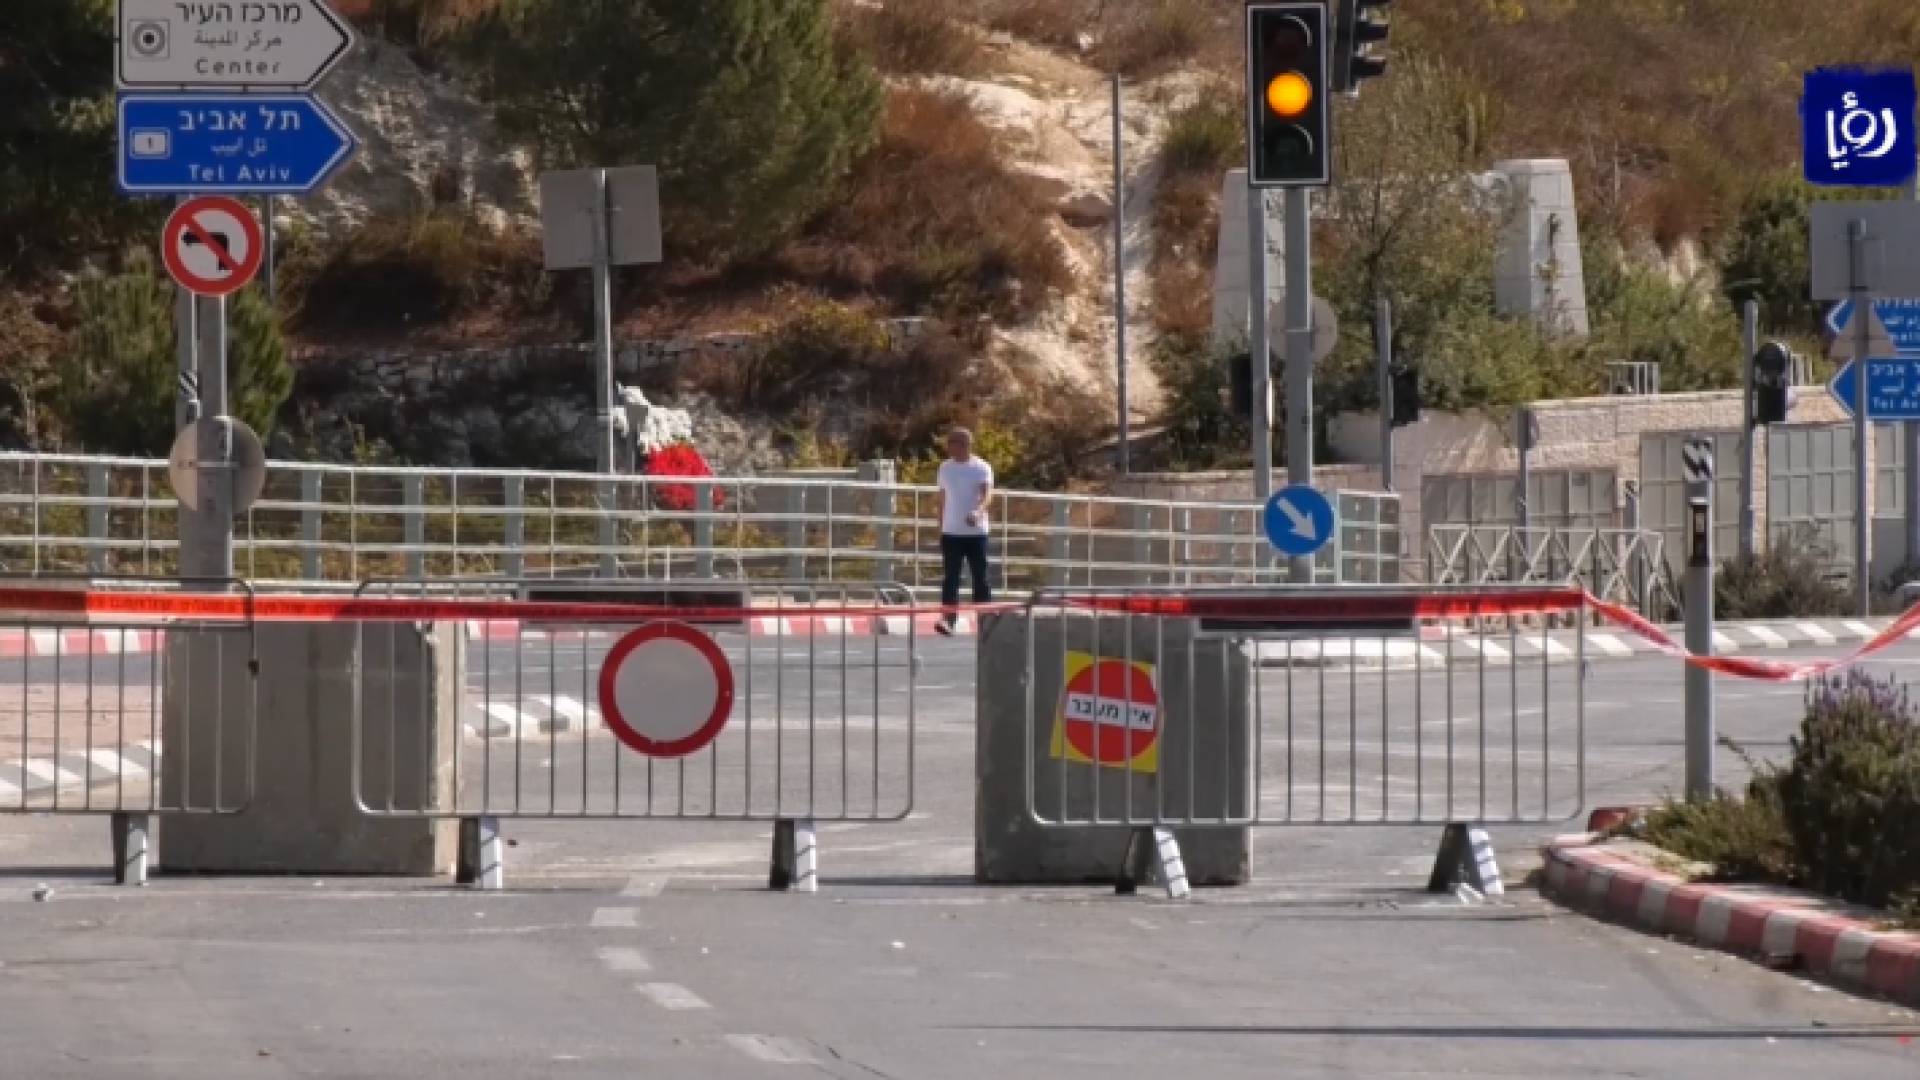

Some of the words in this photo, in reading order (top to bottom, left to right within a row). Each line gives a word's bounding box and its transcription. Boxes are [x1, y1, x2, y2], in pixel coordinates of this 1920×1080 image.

[176, 2, 233, 25] העיר
[240, 2, 302, 24] מרכז
[244, 30, 282, 52] مركز
[195, 58, 280, 75] Center
[178, 109, 247, 131] אביב
[259, 105, 301, 131] תל
[188, 164, 224, 181] Tel
[237, 164, 291, 181] Aviv
